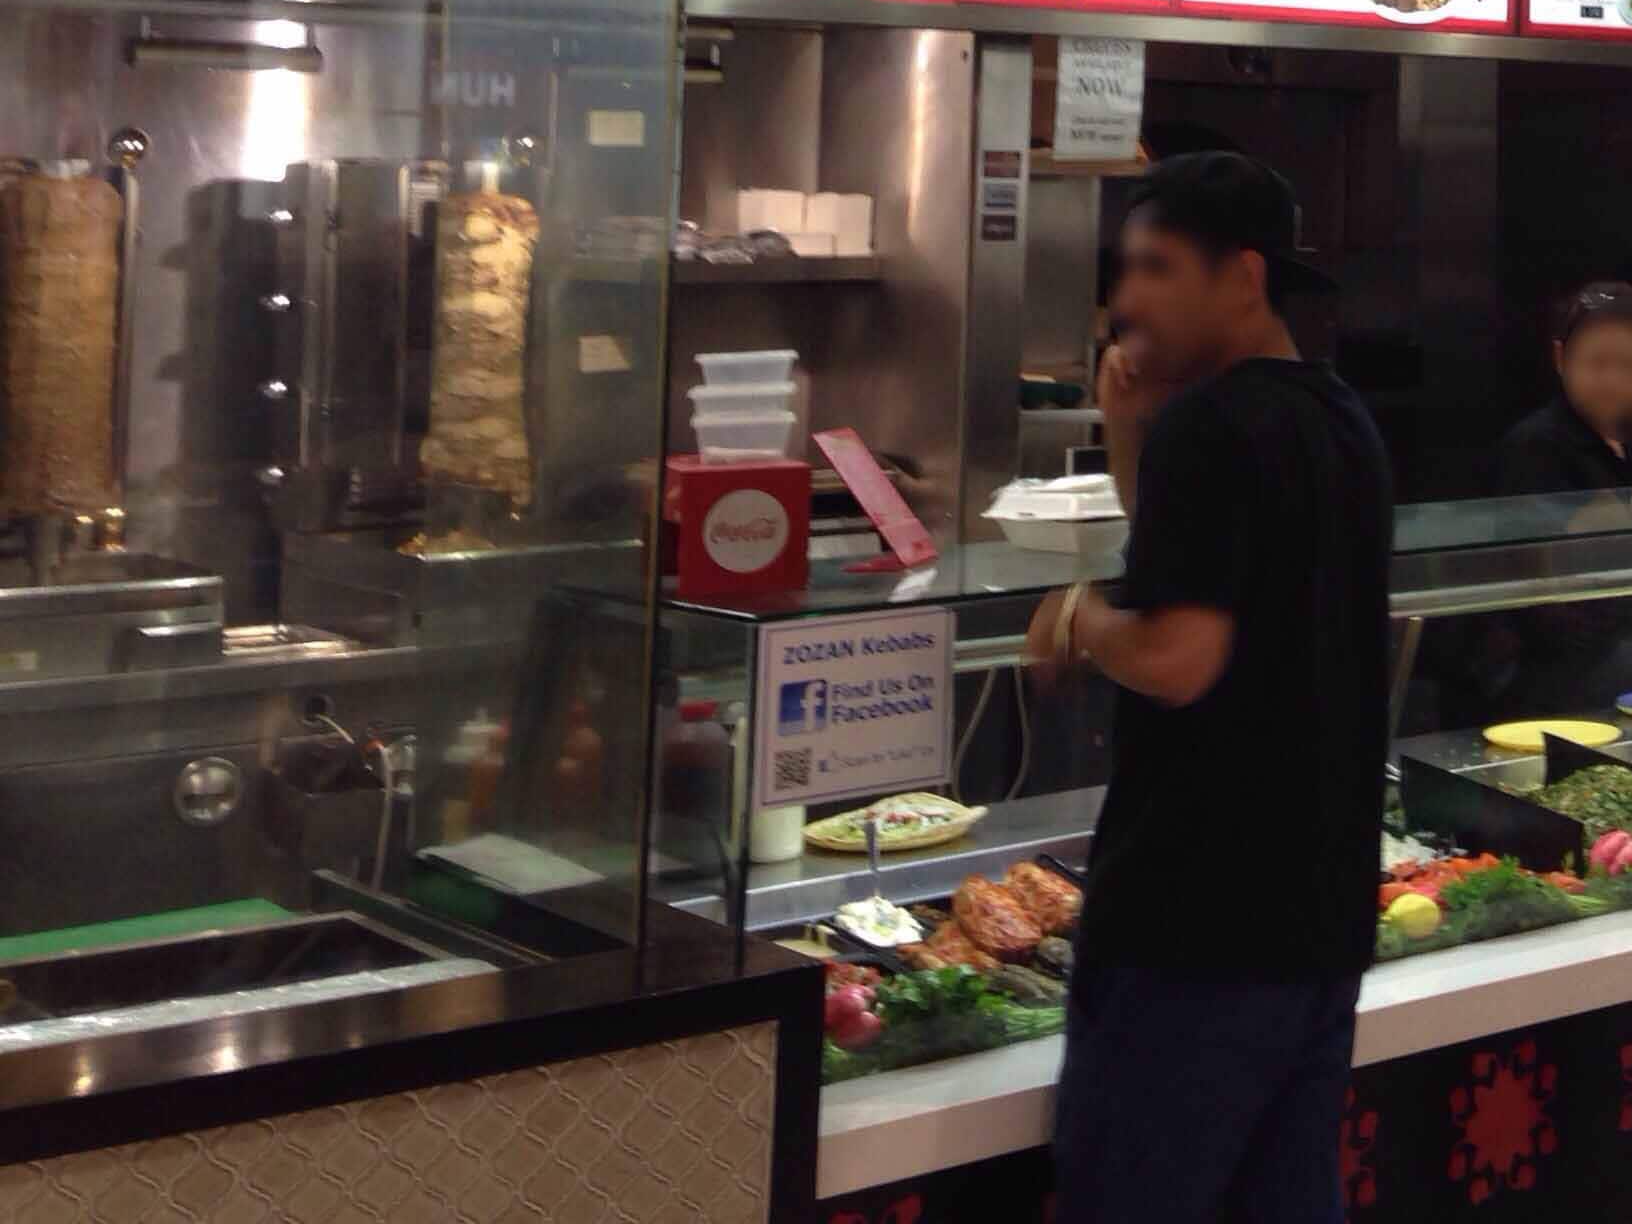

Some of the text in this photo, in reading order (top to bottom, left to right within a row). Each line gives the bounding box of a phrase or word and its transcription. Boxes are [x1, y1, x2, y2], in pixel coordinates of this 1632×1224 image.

[783, 632, 937, 665] ZOZAN Kebabs
[832, 679, 875, 700] Find
[831, 693, 935, 725] Facebook
